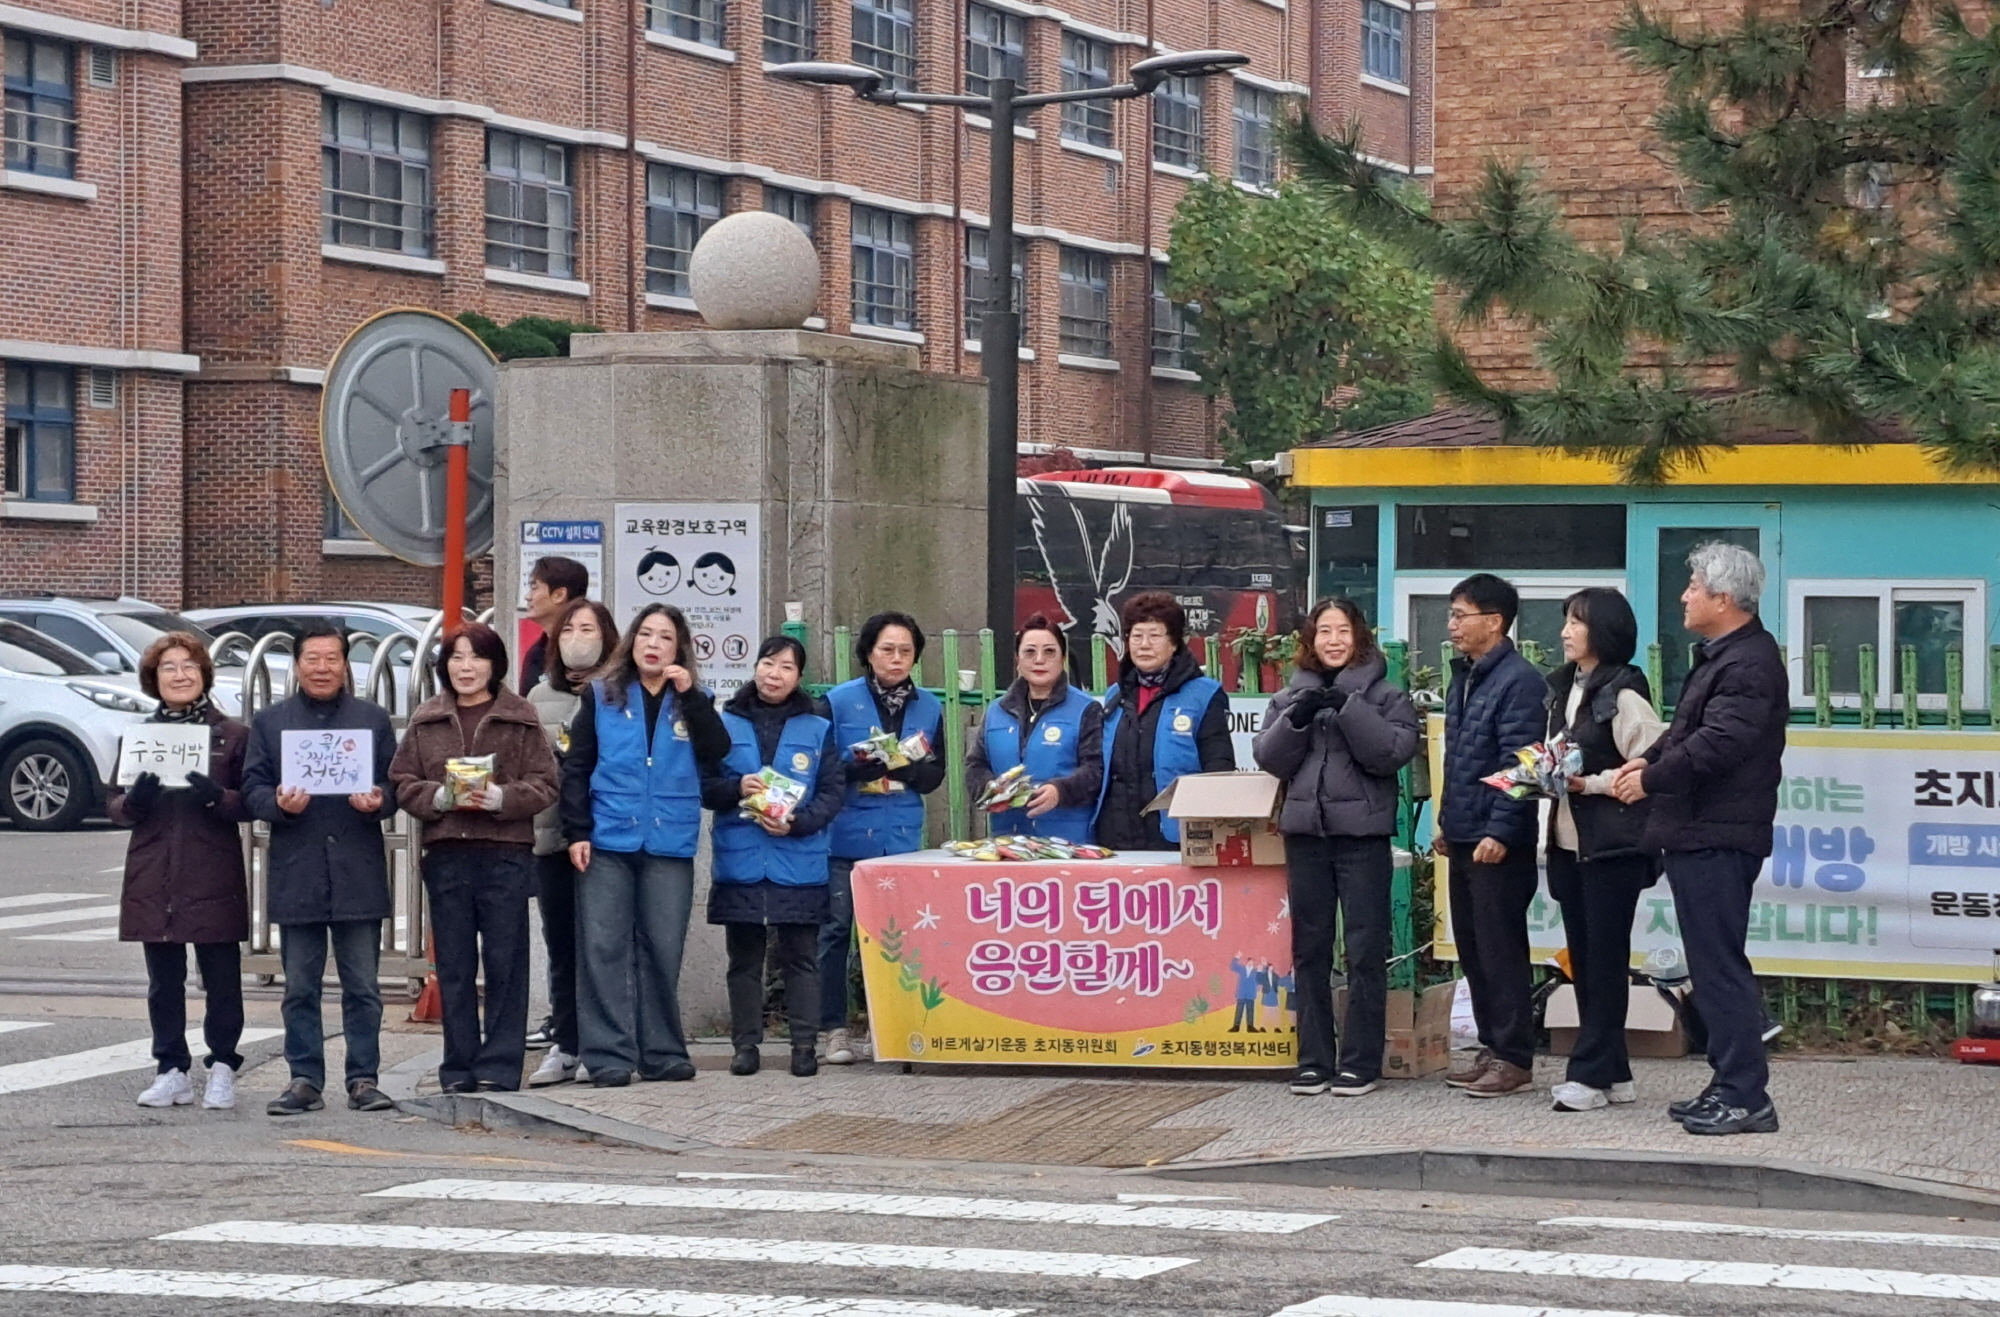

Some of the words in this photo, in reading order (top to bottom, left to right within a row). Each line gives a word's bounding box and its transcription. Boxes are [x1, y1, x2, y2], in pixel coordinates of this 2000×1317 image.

[541, 526, 563, 538] CCTV
[625, 518, 748, 536] 교육환경보호구역
[301, 763, 346, 787] 정답
[1913, 769, 2000, 808] 초지
[1926, 834, 1970, 857] 개방
[1976, 835, 2000, 858] 시
[968, 880, 1062, 932] 너의
[1076, 880, 1221, 933] 뒤에서
[968, 942, 1194, 994] 응원할께~
[931, 1037, 1027, 1052] 바르게살기운동
[1033, 1038, 1118, 1054] 초지동위원회
[1160, 1040, 1292, 1056] 초지동행정복지센터
